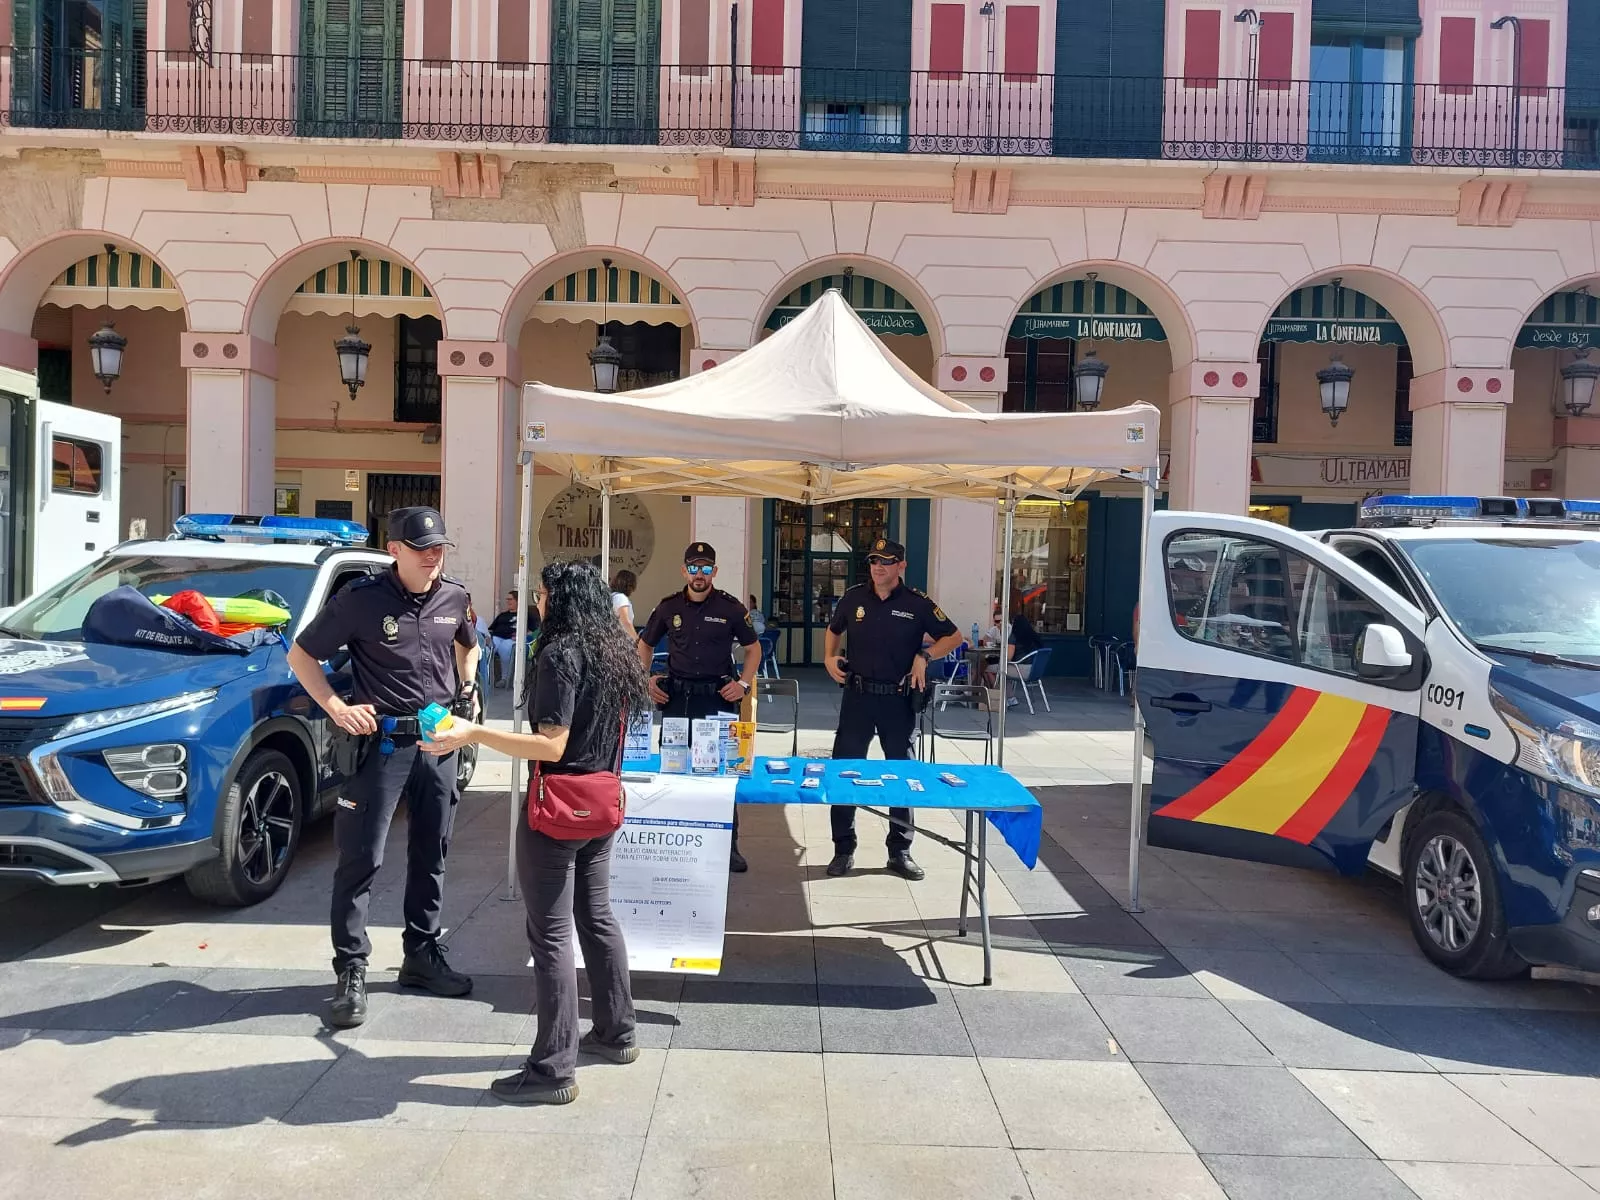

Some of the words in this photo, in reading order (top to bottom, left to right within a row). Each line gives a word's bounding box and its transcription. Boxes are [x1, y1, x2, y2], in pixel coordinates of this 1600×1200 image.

[1029, 319, 1070, 331] ULTRAMARINOS
[1077, 319, 1089, 337] LA
[1092, 319, 1142, 338] CONFIANZA
[1267, 323, 1308, 335] ULTRAMARINOS
[1316, 323, 1328, 341] LA
[1330, 323, 1381, 342] CONFIANZA
[1533, 329, 1562, 342] desde
[556, 524, 634, 550] TRASTINDA
[135, 629, 147, 638] KIT
[145, 630, 156, 640] DE
[617, 831, 703, 848] ALERTCOPS
